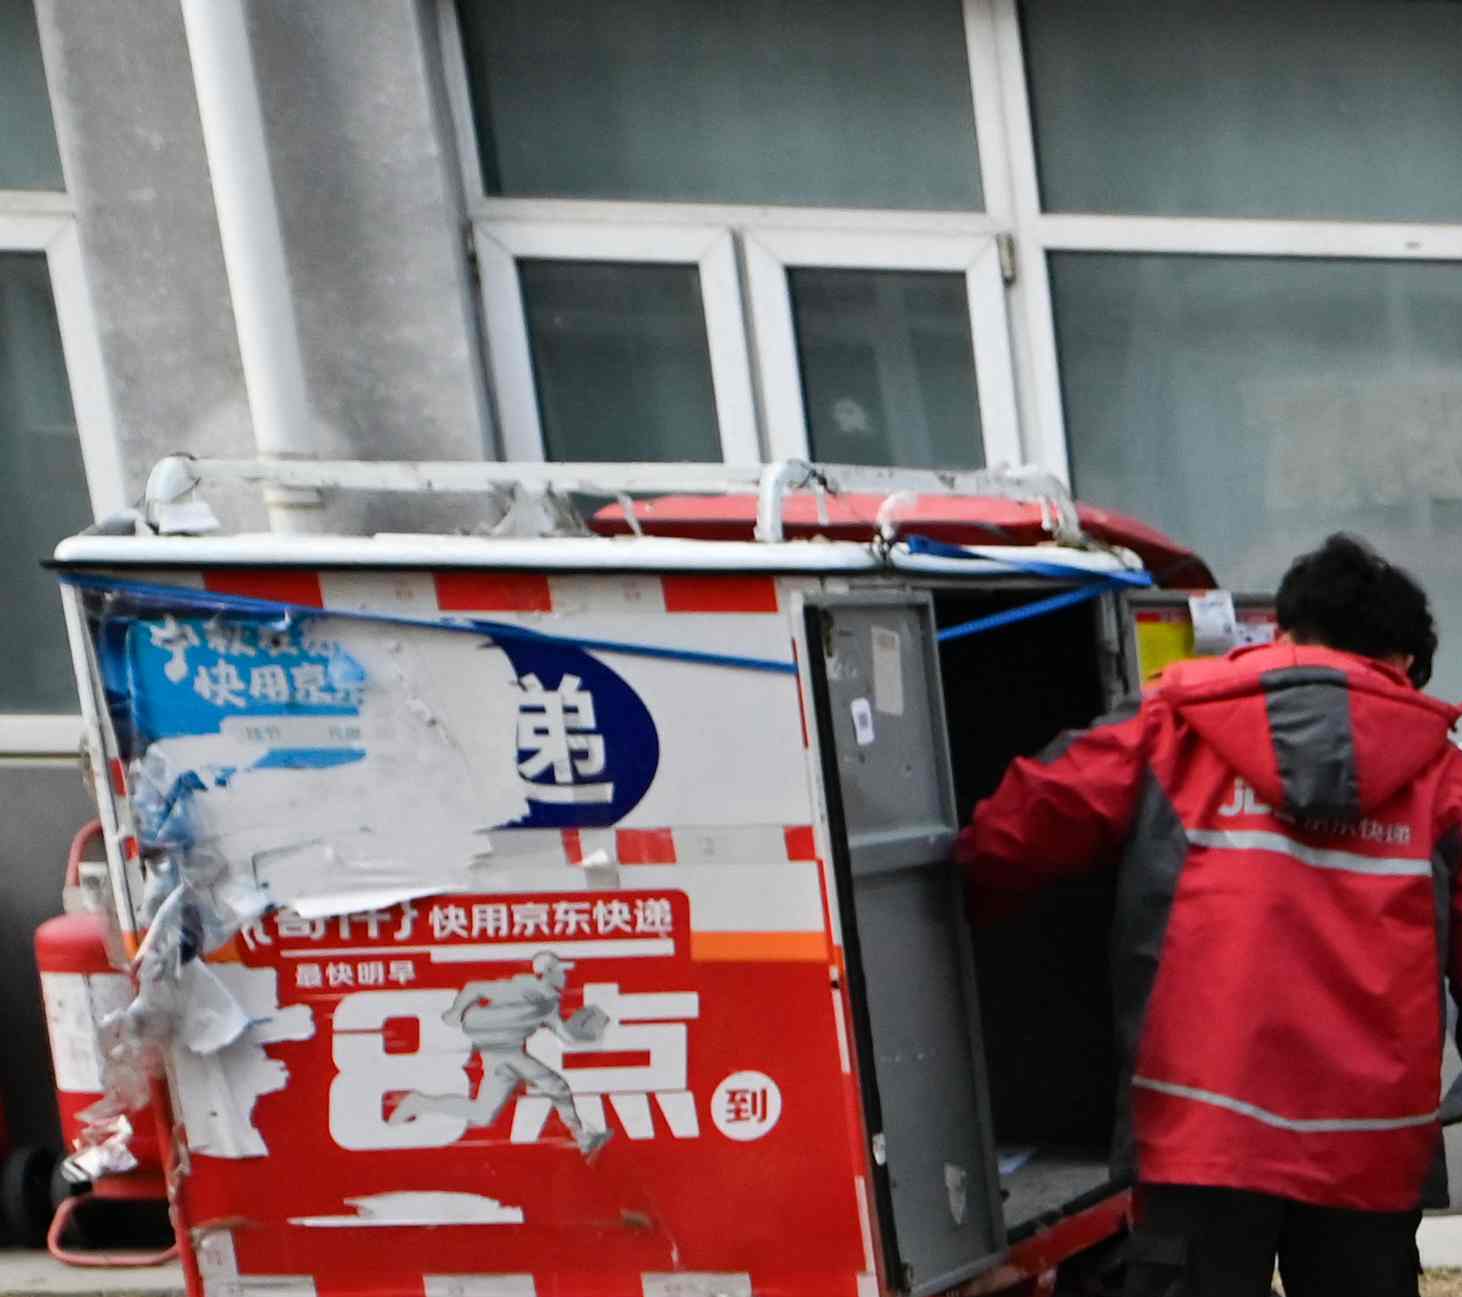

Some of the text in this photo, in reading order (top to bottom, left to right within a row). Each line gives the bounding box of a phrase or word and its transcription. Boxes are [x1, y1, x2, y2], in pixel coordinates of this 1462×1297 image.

[430, 898, 674, 942] 快用京东快递
[295, 961, 416, 986] 最快明早
[725, 1086, 769, 1124] 到
